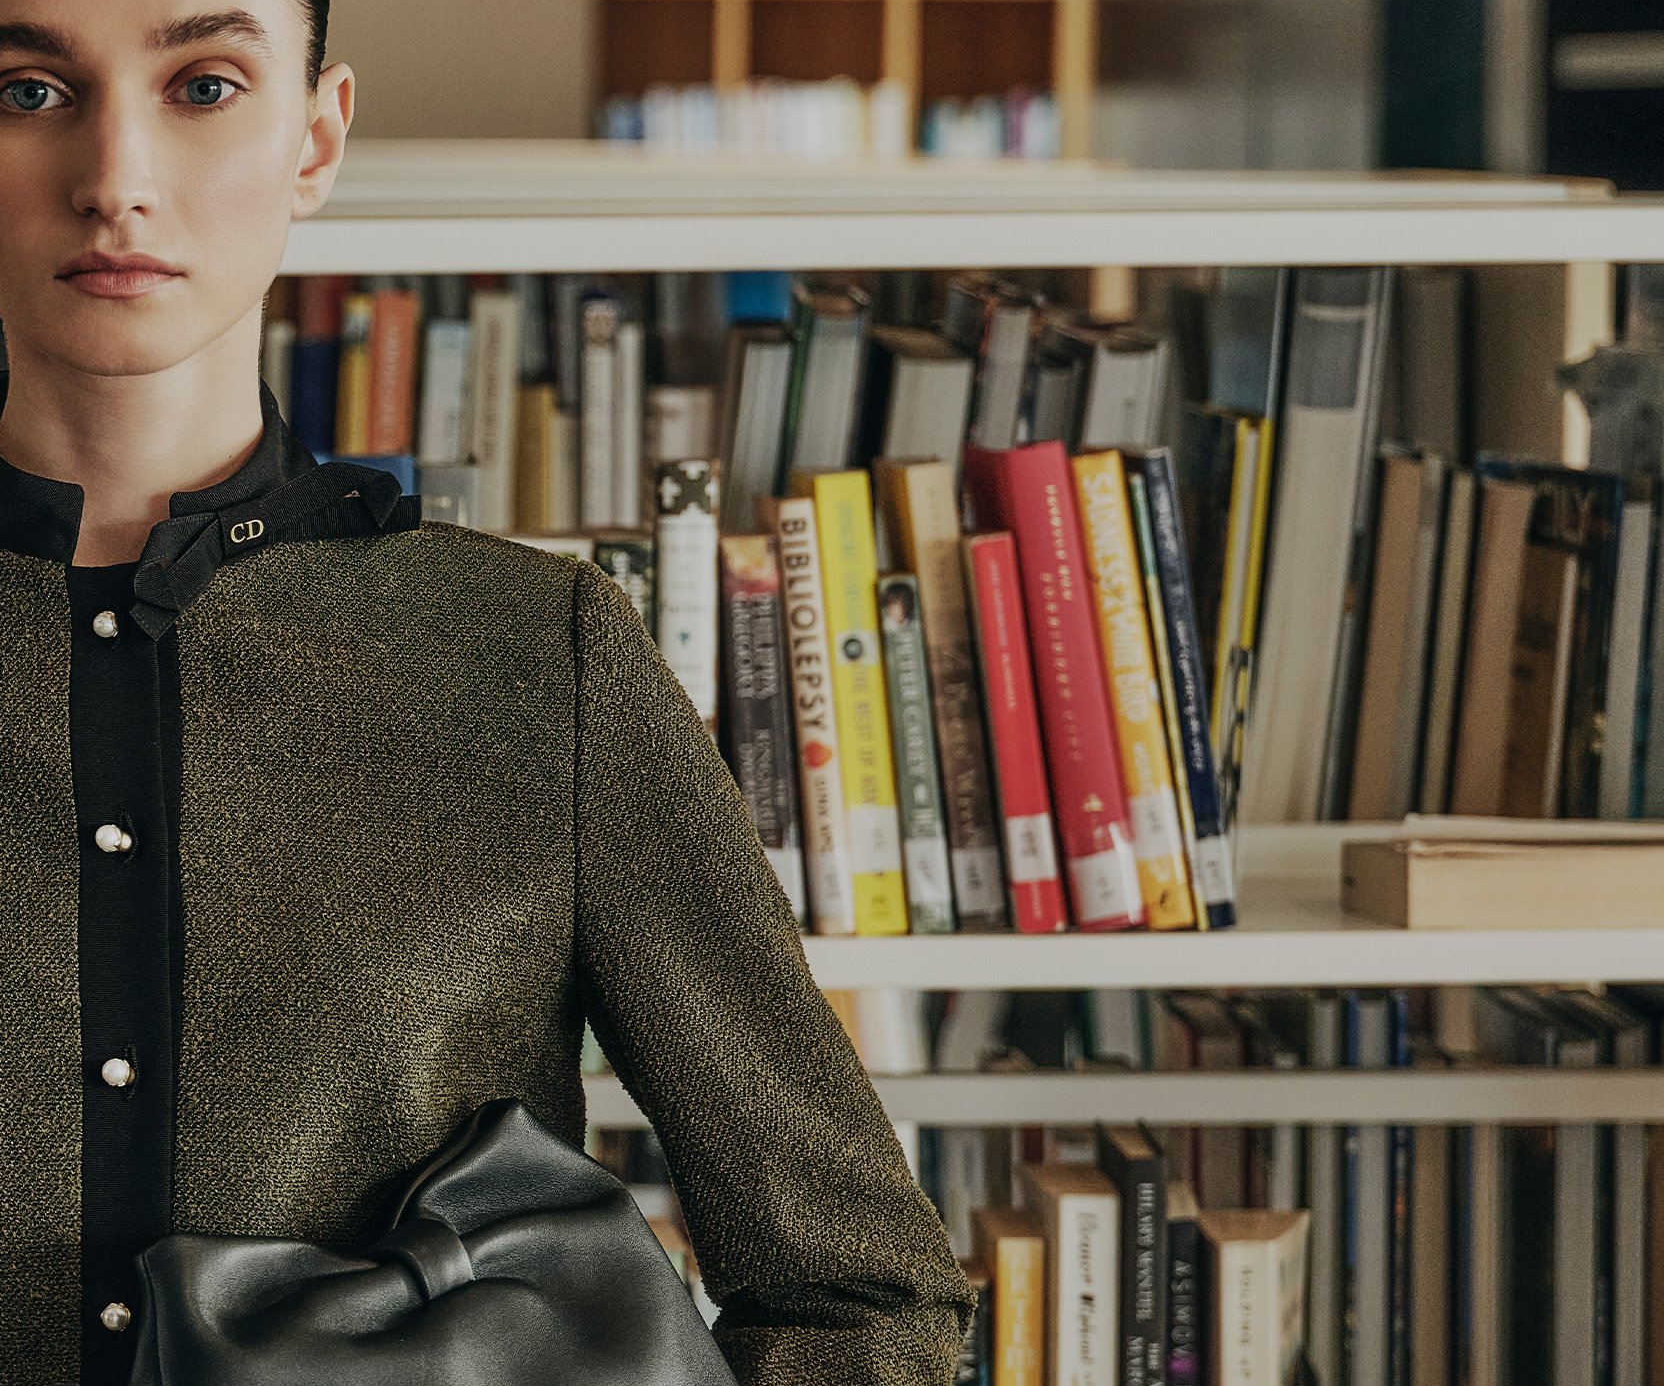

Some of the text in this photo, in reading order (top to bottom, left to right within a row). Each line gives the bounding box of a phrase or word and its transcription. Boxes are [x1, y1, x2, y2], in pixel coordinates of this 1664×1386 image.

[230, 519, 265, 544] CD
[1082, 472, 1128, 594] SADNESS
[781, 517, 828, 732] BIBLIOLEPSY
[1170, 1259, 1194, 1361] ASIMOV
